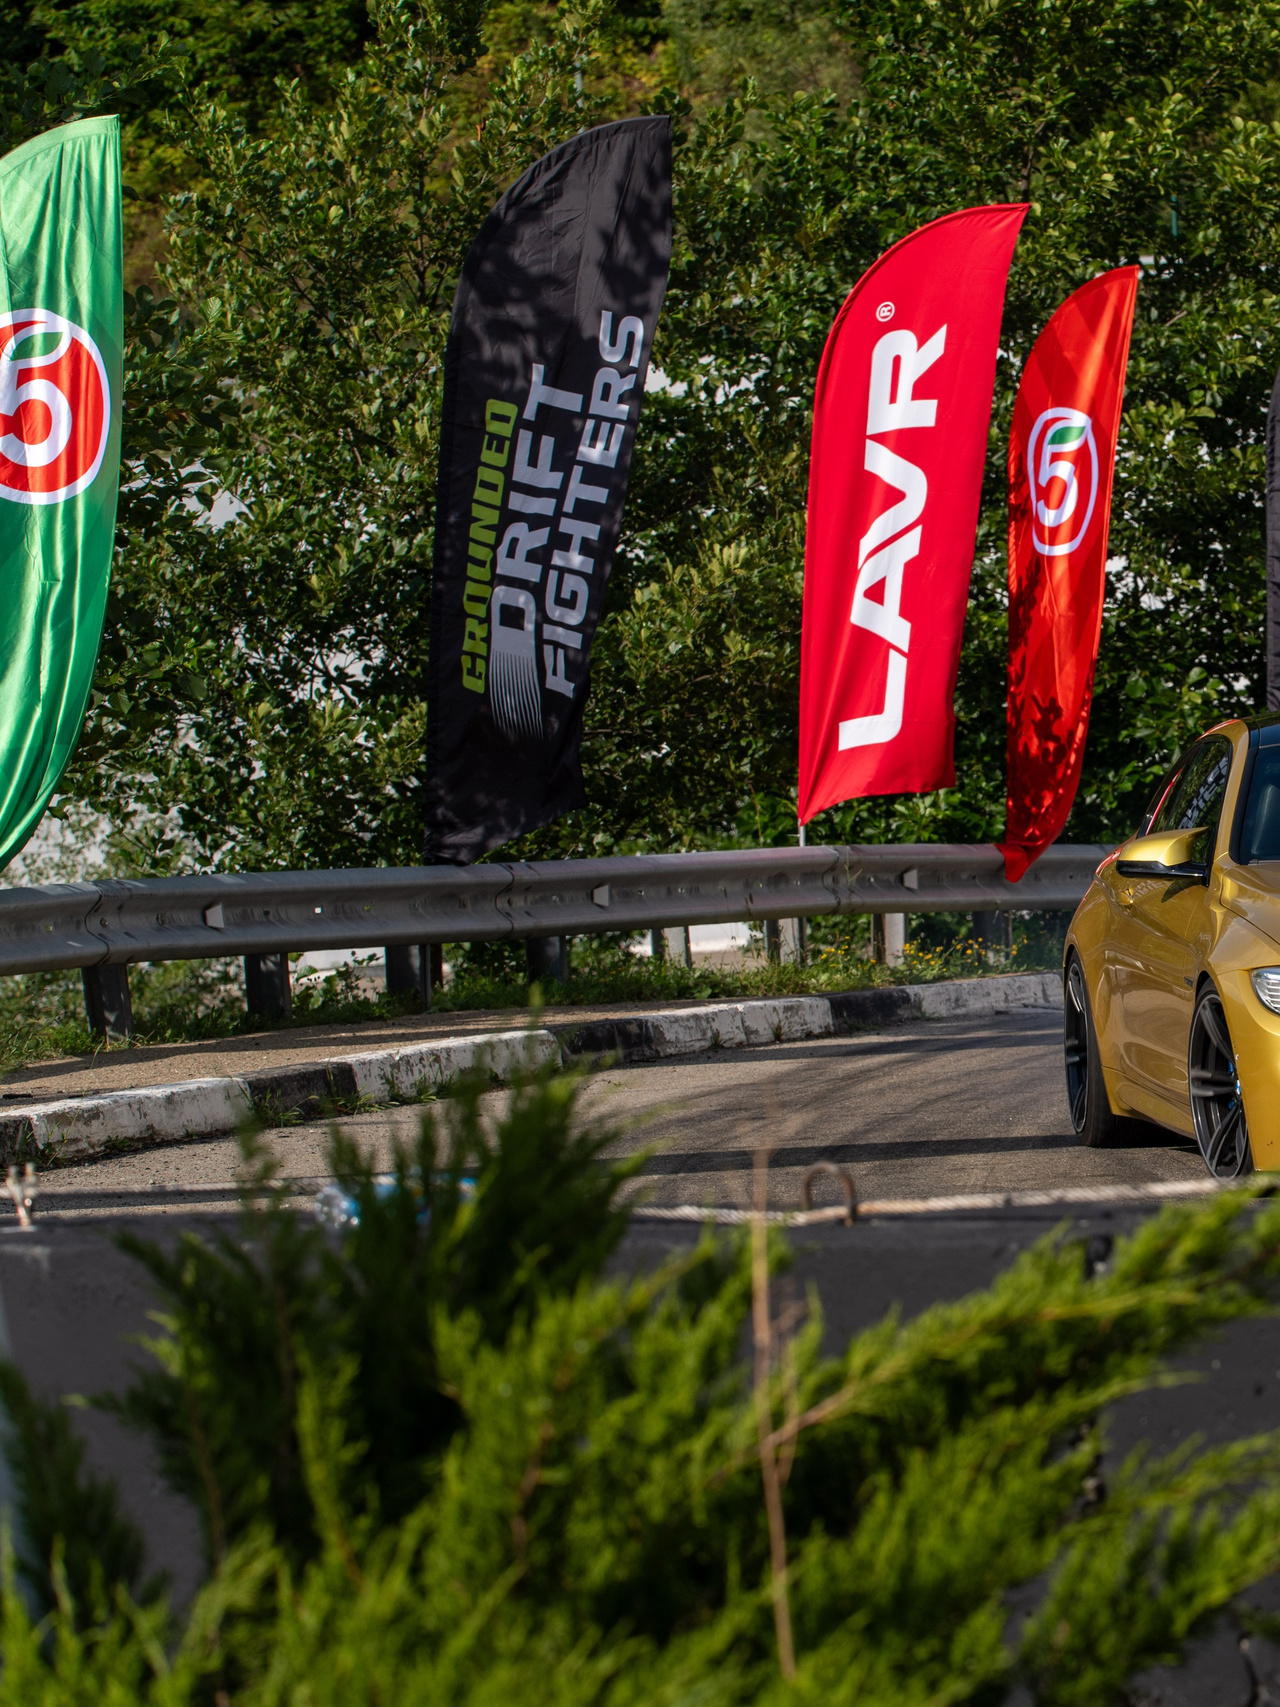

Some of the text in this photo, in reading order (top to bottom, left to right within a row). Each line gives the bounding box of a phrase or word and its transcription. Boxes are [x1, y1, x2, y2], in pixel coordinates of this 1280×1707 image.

[461, 398, 519, 694] GROUNDED
[489, 363, 584, 739] DRIFT
[542, 310, 645, 699] FIGHTERS
[1037, 418, 1088, 527] 5
